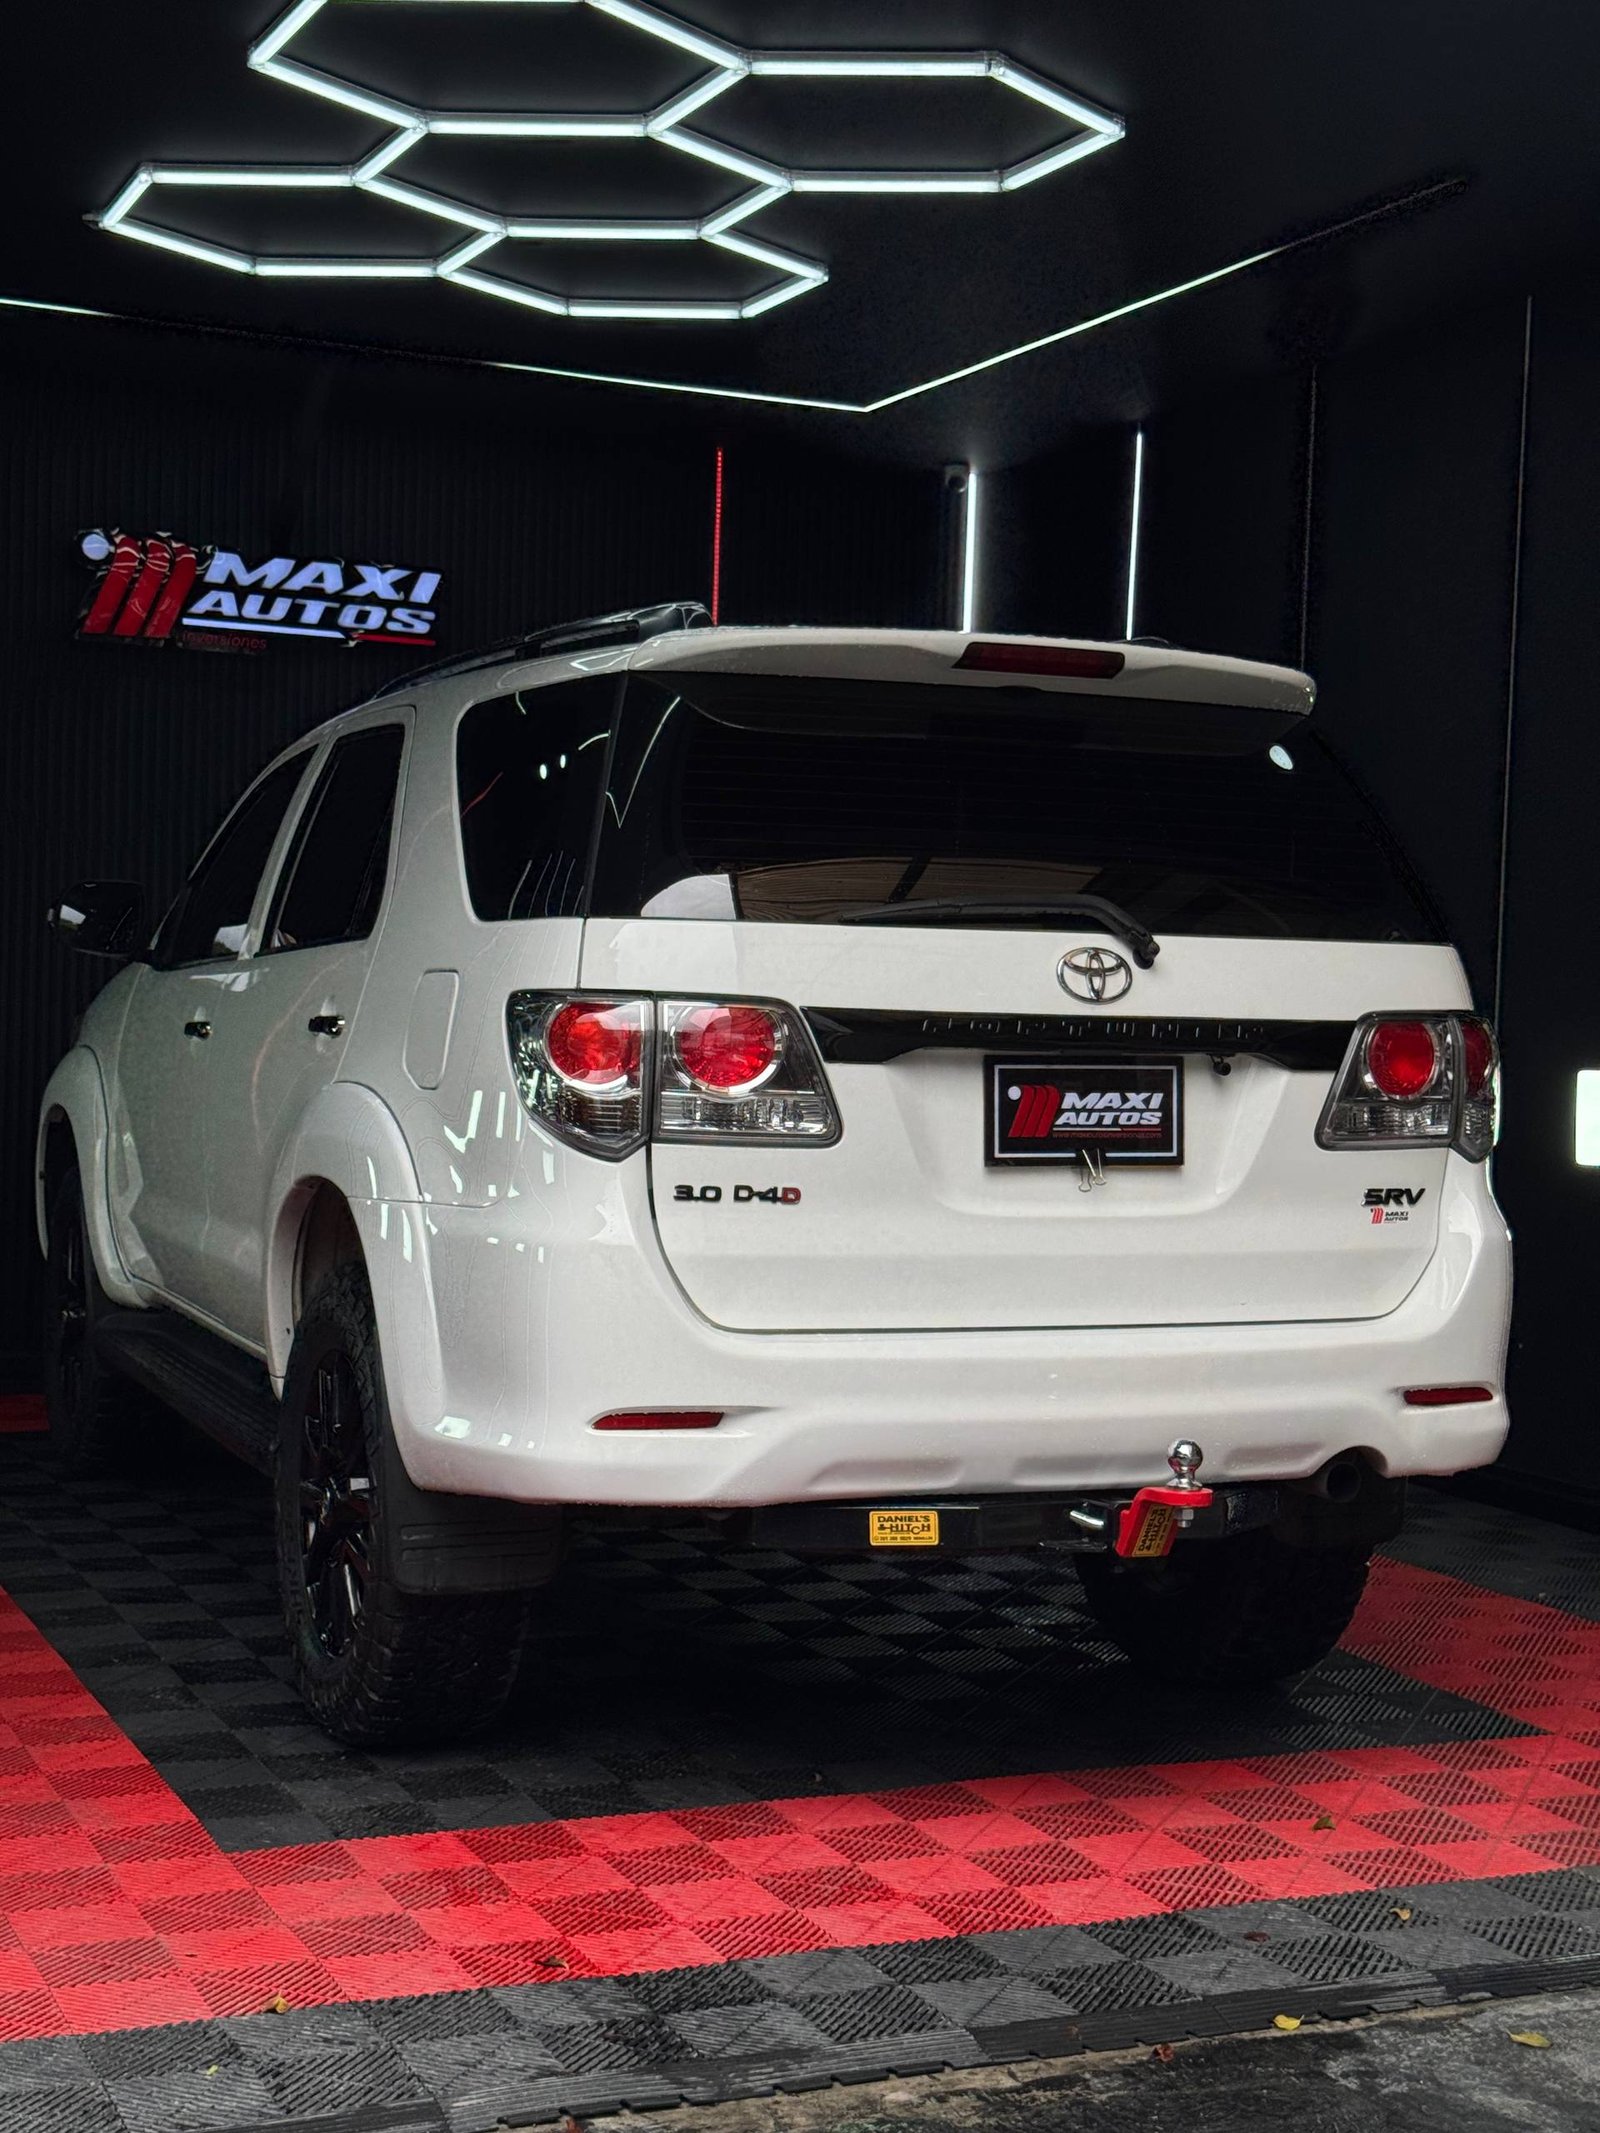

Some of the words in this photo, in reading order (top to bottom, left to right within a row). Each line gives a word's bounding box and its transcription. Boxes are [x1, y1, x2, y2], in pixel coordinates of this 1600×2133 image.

[203, 551, 441, 604] MAXI
[187, 589, 436, 634] AUTOS
[1060, 1092, 1164, 1110] MAXI
[1054, 1111, 1163, 1126] AUTOS
[673, 1184, 722, 1202] 3.0
[1361, 1187, 1426, 1207] SRV
[877, 1515, 931, 1523] DANIEL'S
[889, 1523, 931, 1535] HITCH
